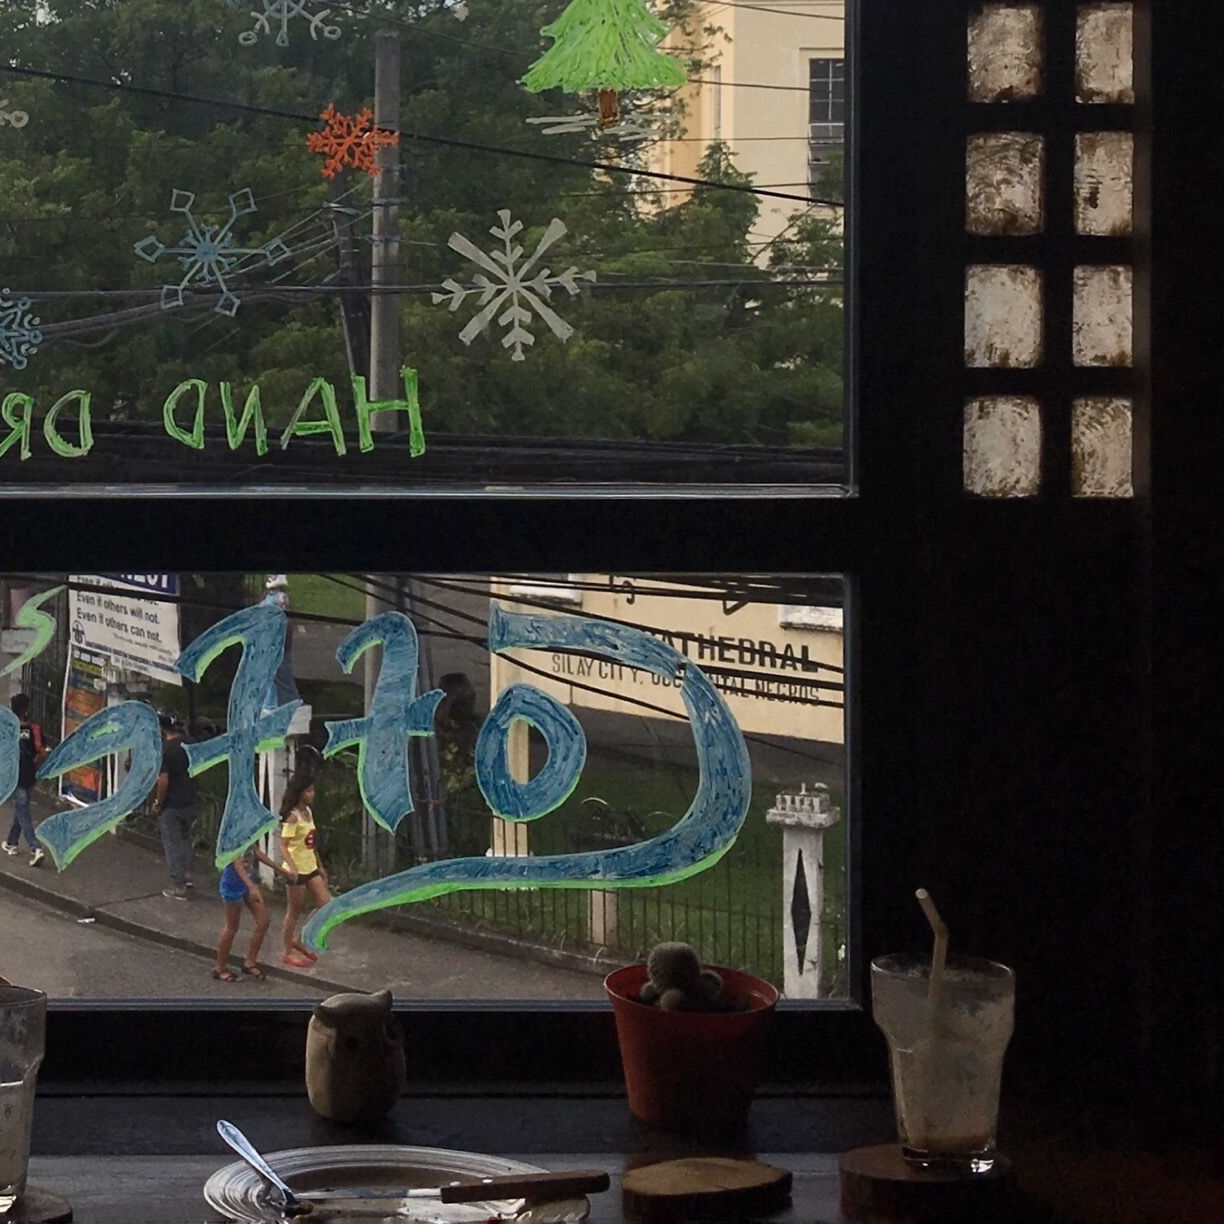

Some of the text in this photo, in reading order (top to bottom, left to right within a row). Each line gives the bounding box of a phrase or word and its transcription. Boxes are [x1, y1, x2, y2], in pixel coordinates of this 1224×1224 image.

[76, 591, 96, 606] Even
[103, 599, 128, 616] others
[130, 606, 144, 620] will
[76, 608, 97, 623] Even
[105, 616, 129, 633] others
[130, 625, 146, 639] can
[552, 652, 594, 678] SILAY
